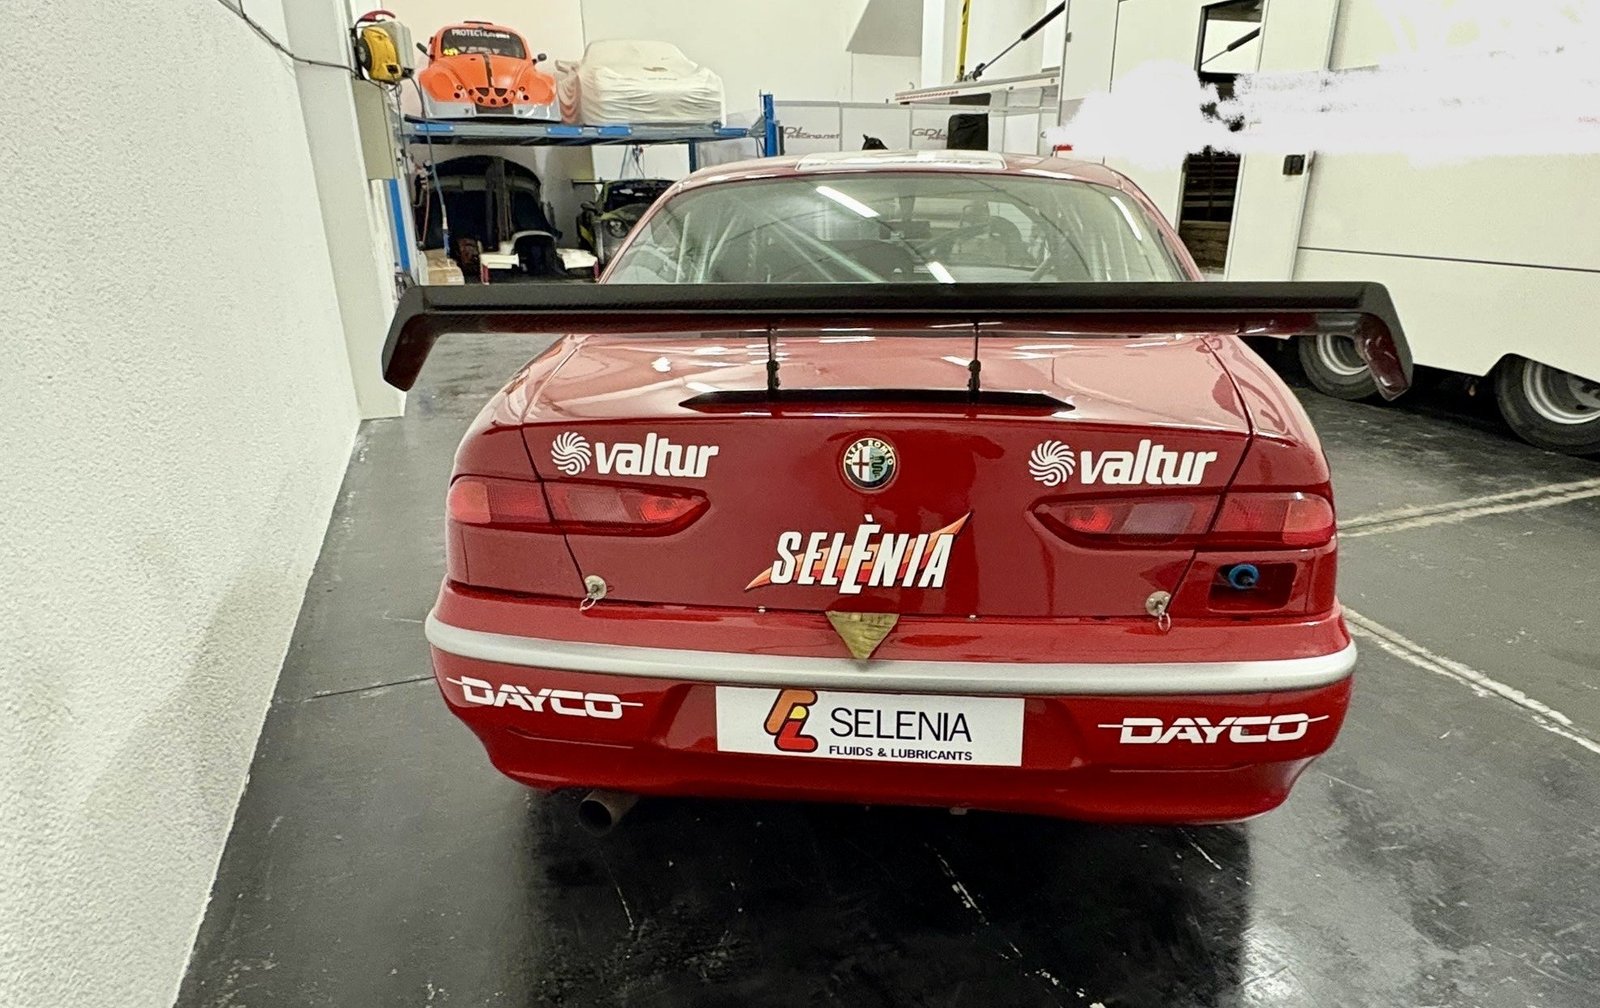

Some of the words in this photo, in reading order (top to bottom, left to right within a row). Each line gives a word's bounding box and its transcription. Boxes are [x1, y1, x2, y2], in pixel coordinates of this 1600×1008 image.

[595, 432, 719, 478] valtur
[845, 442, 864, 466] ALFA
[867, 440, 894, 466] ROMEO
[1080, 439, 1218, 485] valtur
[770, 514, 954, 594] SELÈNIA
[461, 676, 624, 720] DAYCO
[829, 706, 973, 743] SELENIA
[1118, 712, 1309, 744] DAYCO
[828, 745, 874, 757] FLUIDS
[877, 747, 888, 758] &
[890, 748, 973, 762] LUBRICANTS
